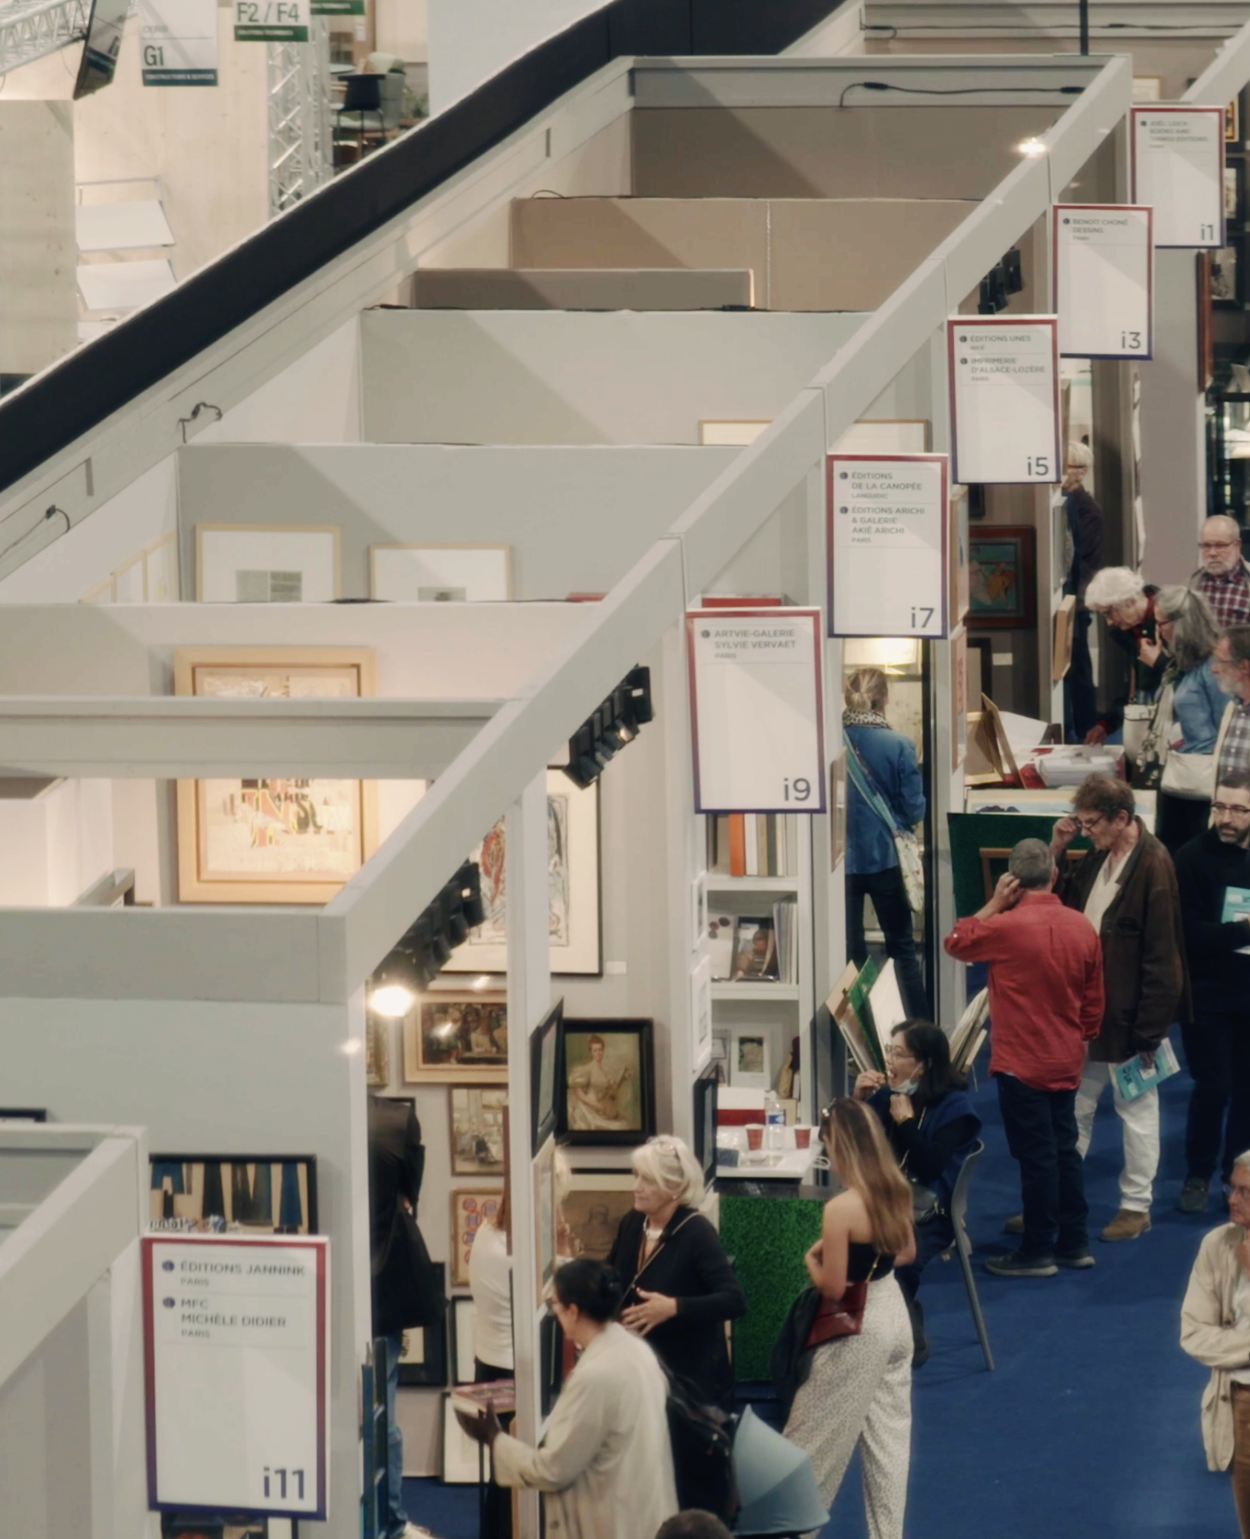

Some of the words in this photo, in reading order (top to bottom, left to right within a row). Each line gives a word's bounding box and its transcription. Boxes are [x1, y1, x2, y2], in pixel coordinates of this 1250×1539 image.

[237, 2, 259, 22] F2
[277, 2, 299, 22] F4
[143, 45, 165, 67] G1
[1201, 224, 1214, 241] i1
[1121, 331, 1141, 349] i3
[1027, 456, 1049, 476] i5
[851, 471, 893, 480] ÉDITIONS
[852, 482, 864, 490] DE
[879, 482, 922, 490] CANOPÉE
[852, 506, 893, 514] ÉDITIONS
[895, 507, 925, 515] ARICHI
[852, 526, 873, 534] AKIÉ
[911, 607, 935, 628] i7
[714, 629, 795, 638] ARTVIE-GALERIE
[714, 641, 749, 649] SYLVIE
[751, 641, 796, 649] VERVAET
[784, 777, 811, 801] i9
[180, 1260, 242, 1274] ÉDITIONS
[247, 1264, 305, 1276] JANNINK
[180, 1278, 209, 1286] PARIS
[181, 1298, 209, 1309] MFC
[181, 1313, 238, 1326] MICHÈLE
[242, 1317, 286, 1327] DIDIER
[181, 1330, 210, 1338] PARIS
[263, 1467, 304, 1500] i11
